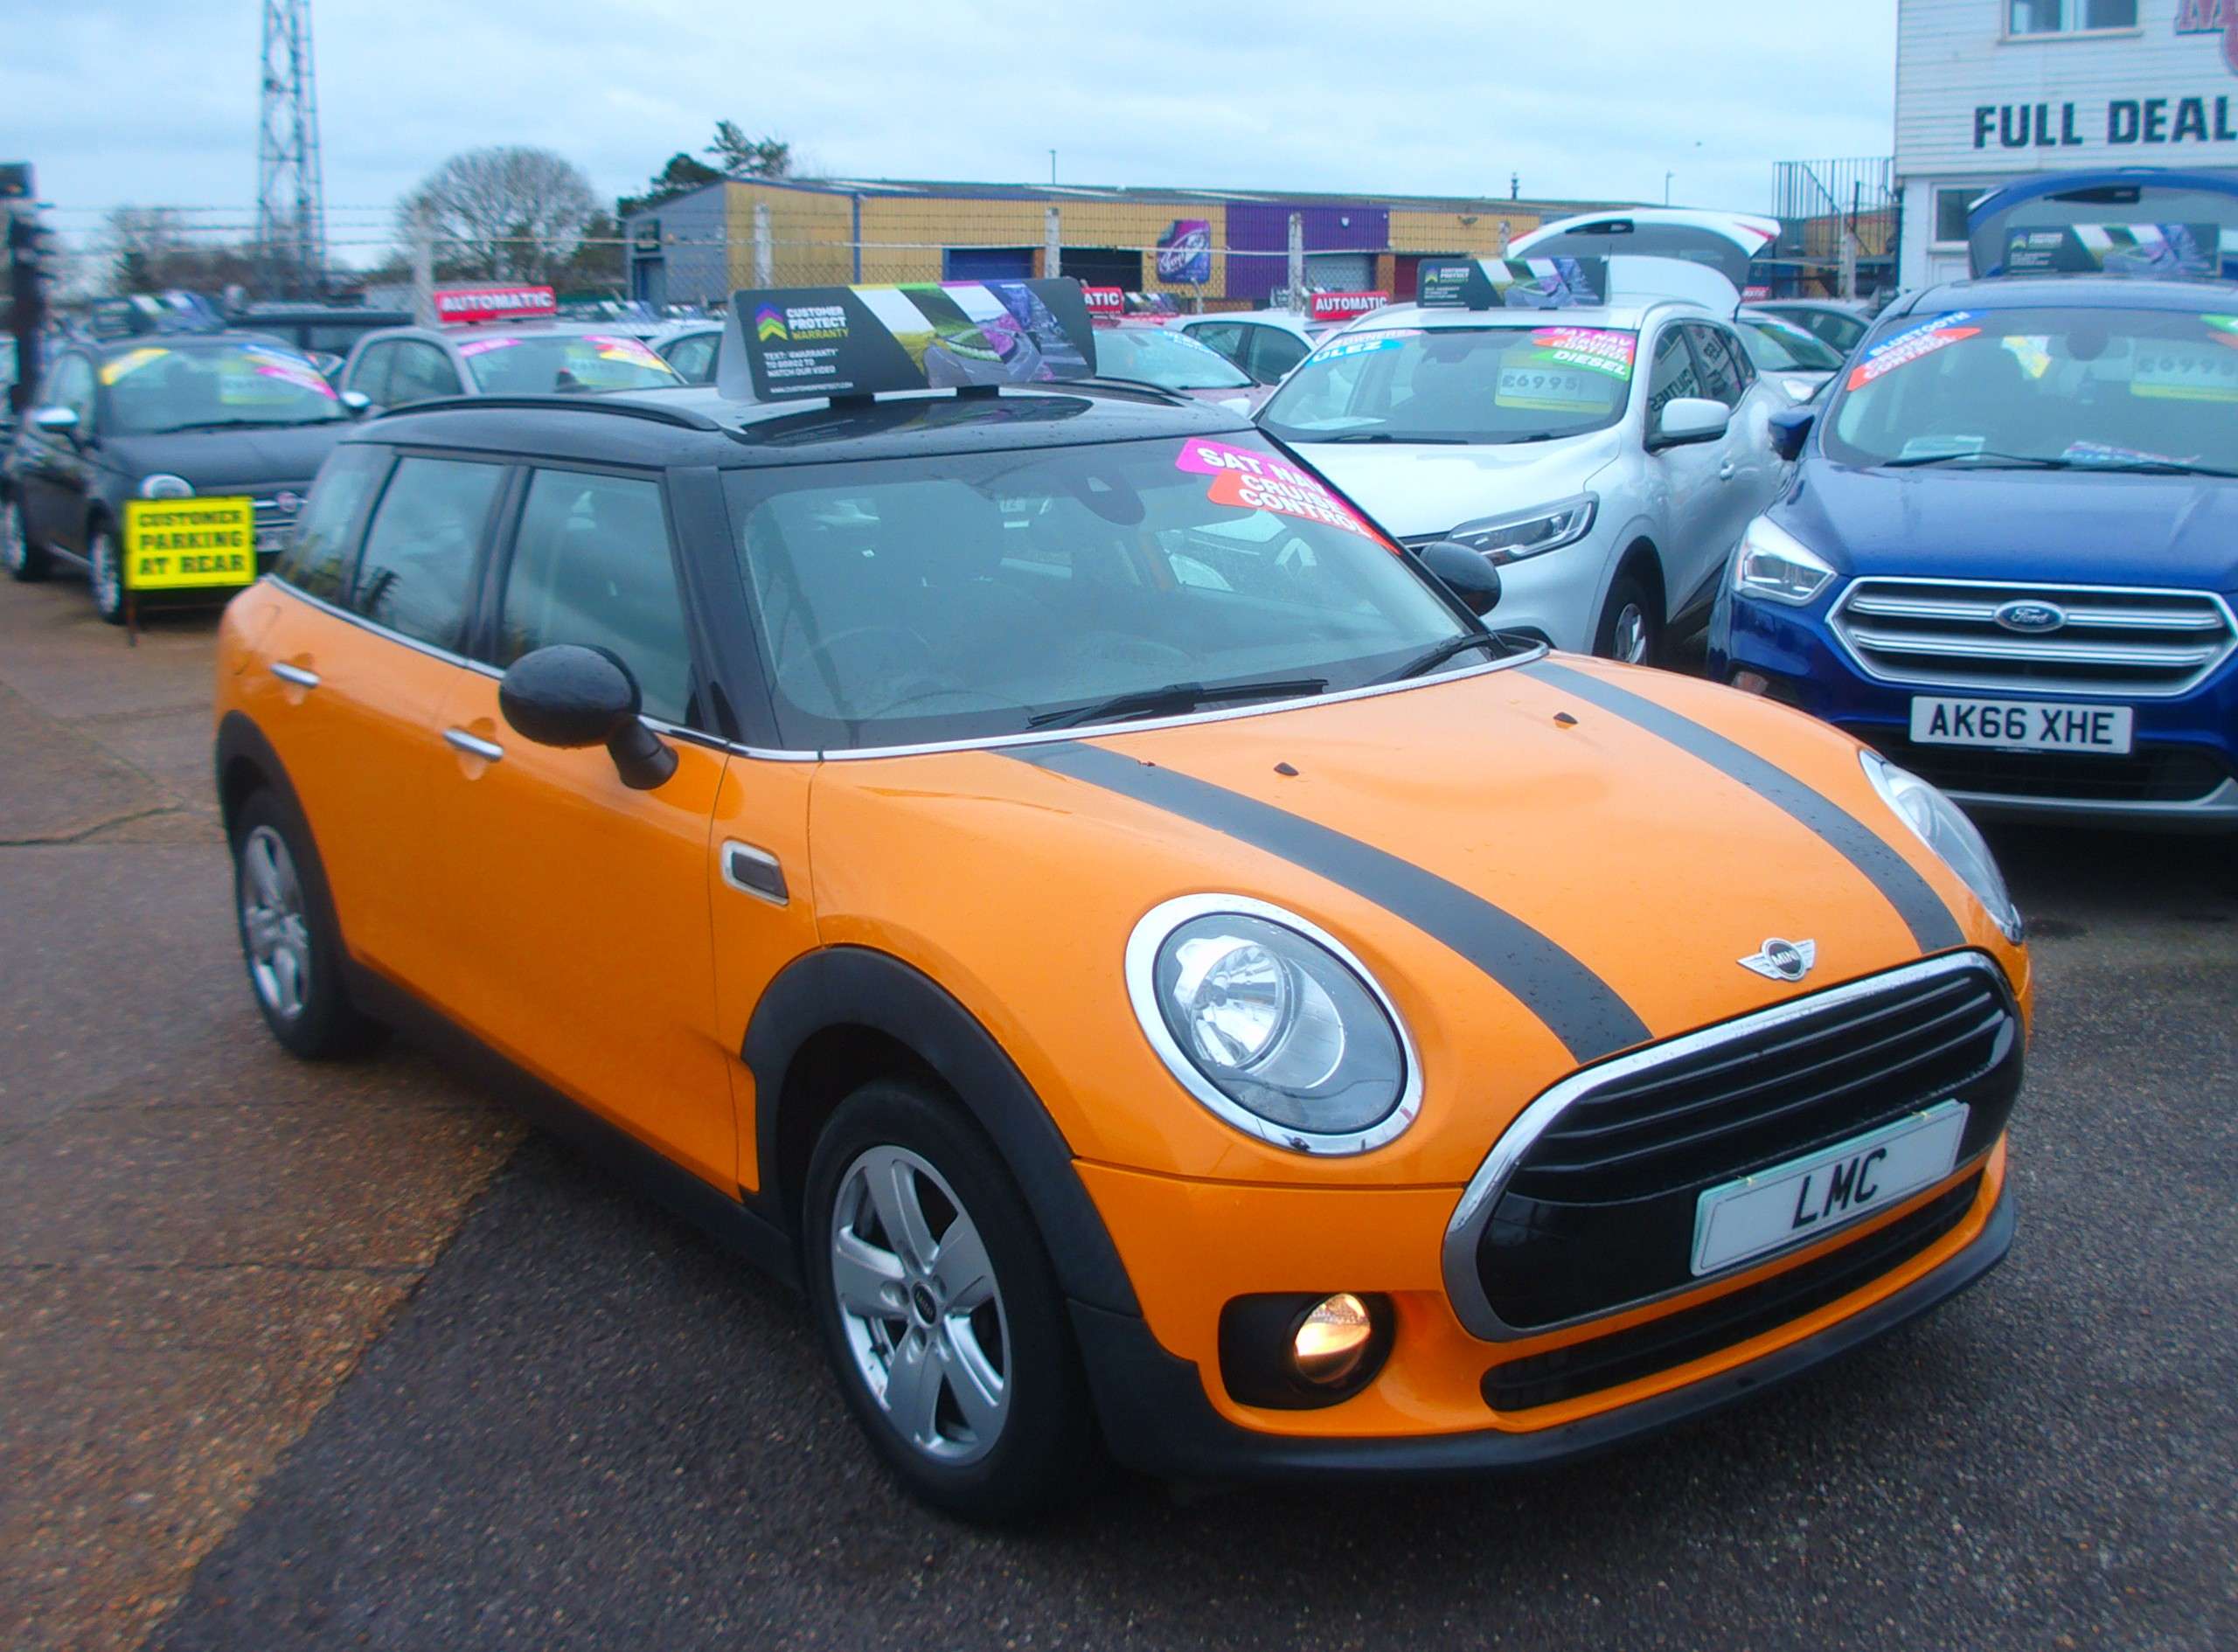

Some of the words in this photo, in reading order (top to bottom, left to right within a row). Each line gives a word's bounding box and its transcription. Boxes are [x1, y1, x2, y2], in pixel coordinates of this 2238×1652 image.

[1973, 103, 2083, 149] FULL
[2107, 96, 2238, 144] DEAL
[441, 291, 552, 312] AUTOMATIC
[786, 306, 845, 318] CUSTOMER
[1316, 296, 1387, 311] AUTOMATIC
[788, 316, 846, 330] PROTECT
[791, 328, 849, 341] WARRANTY
[1553, 350, 1626, 376] DIESEL
[1196, 446, 1264, 475] SAT
[1240, 475, 1346, 514] CRUISE
[139, 510, 242, 527] CUSTOMER
[1238, 489, 1373, 539] CONTROL
[140, 531, 241, 550] PARKING
[140, 557, 169, 575] AT
[180, 554, 244, 573] REAR
[2011, 607, 2050, 623] Ford
[1929, 704, 2027, 740] AK66
[2040, 709, 2115, 745] XHE
[1791, 1148, 1887, 1229] LMC
